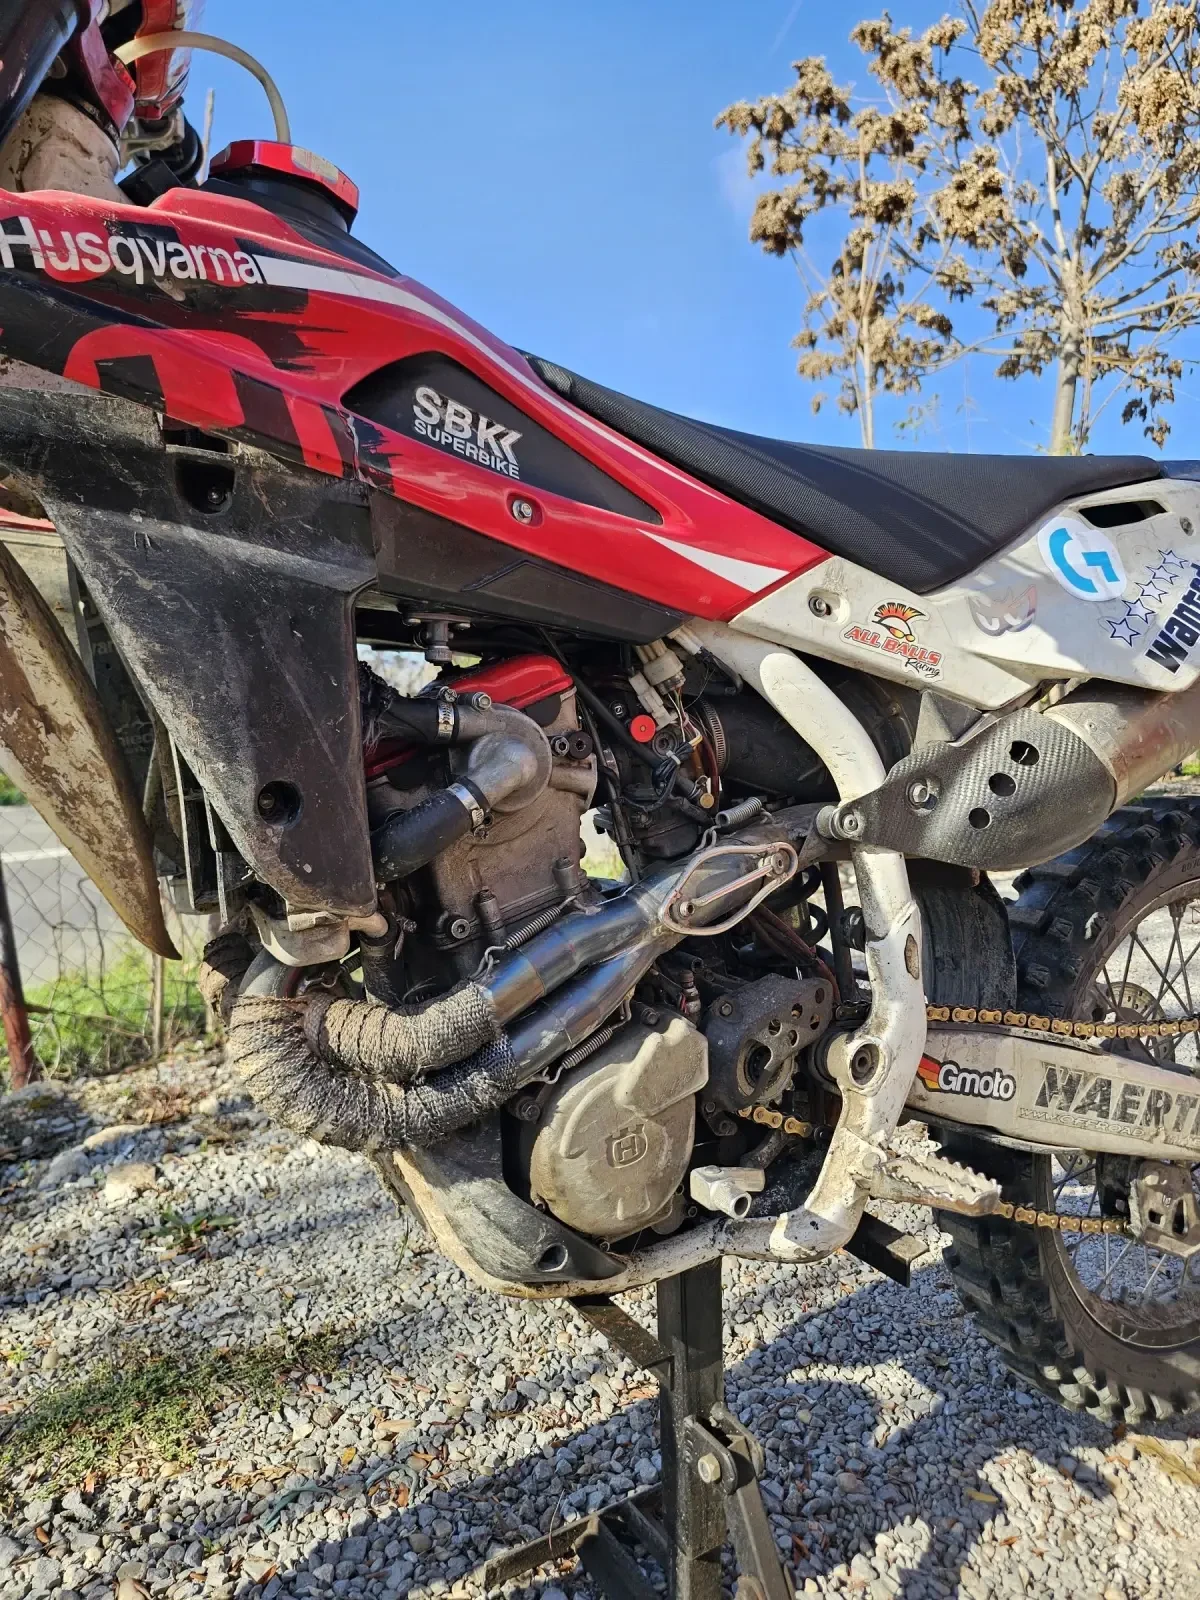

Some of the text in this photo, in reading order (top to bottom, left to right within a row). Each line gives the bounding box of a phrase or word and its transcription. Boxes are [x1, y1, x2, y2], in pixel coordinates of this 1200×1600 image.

[0, 216, 264, 285] Husqvarna
[413, 387, 522, 465] SBK
[414, 419, 520, 480] SUPERBIKE
[844, 626, 942, 666] ALL BALLS
[1144, 562, 1200, 675] Wan
[904, 657, 941, 679] Racing
[938, 1063, 1015, 1099] Gmoto
